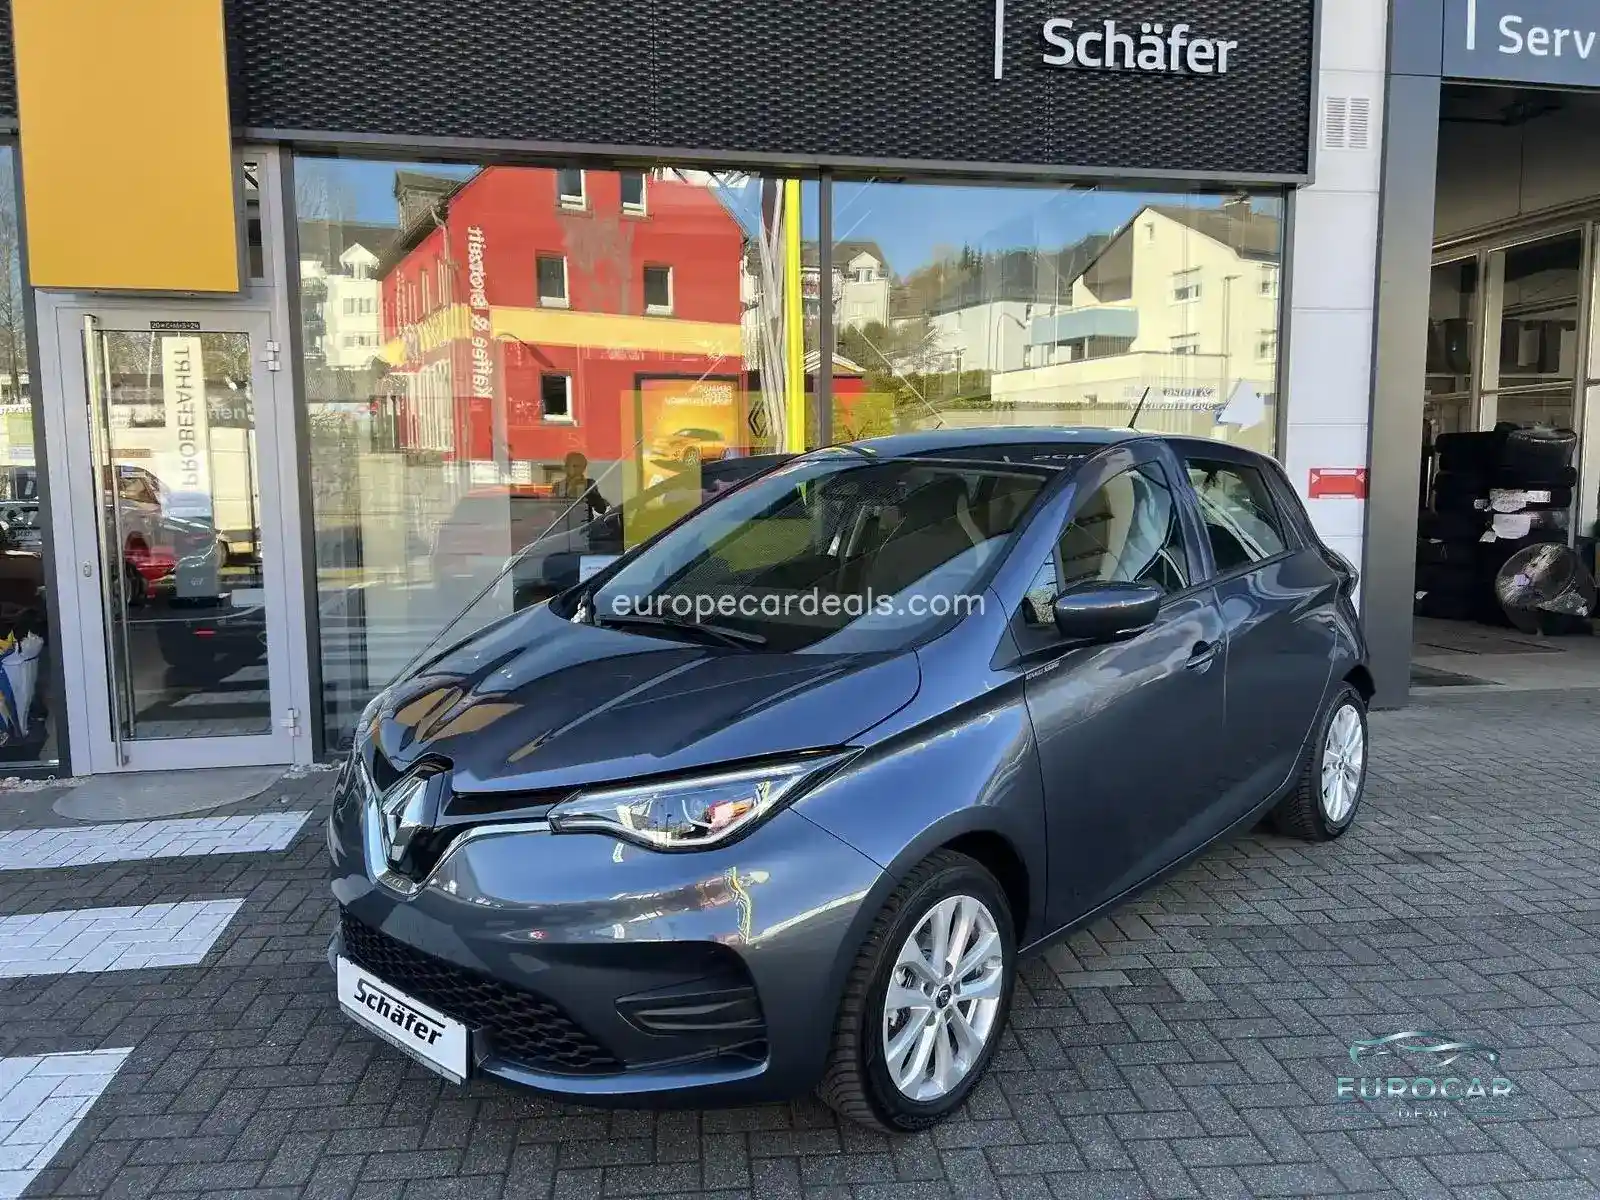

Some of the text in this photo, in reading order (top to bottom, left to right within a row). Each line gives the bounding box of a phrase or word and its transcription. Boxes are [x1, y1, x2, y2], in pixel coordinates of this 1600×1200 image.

[1042, 18, 1238, 75] Schäfer
[1498, 14, 1596, 59] Serv
[354, 977, 445, 1045] Schäfer
